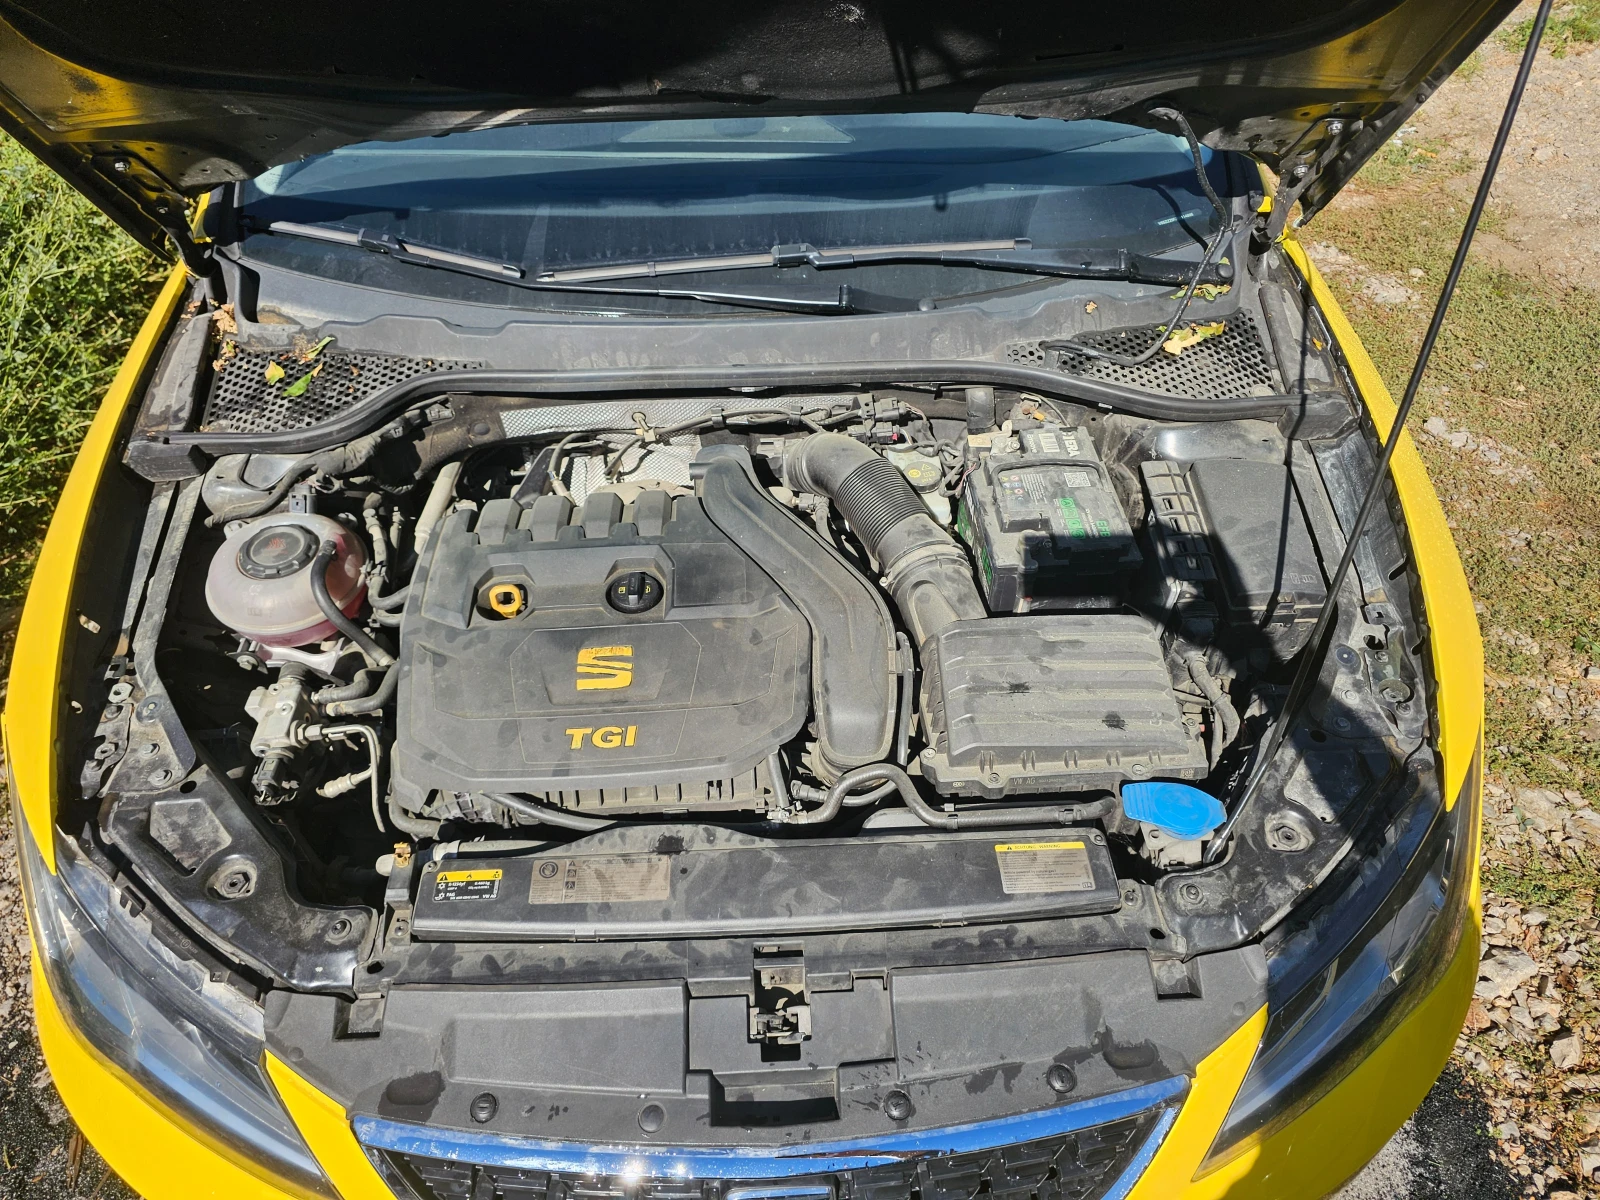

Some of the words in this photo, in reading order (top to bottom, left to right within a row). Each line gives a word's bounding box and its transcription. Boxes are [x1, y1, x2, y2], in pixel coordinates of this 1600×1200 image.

[1095, 519, 1112, 537] EFB
[565, 725, 638, 750] TGI
[1013, 777, 1023, 785] VW
[1025, 777, 1036, 785] AG
